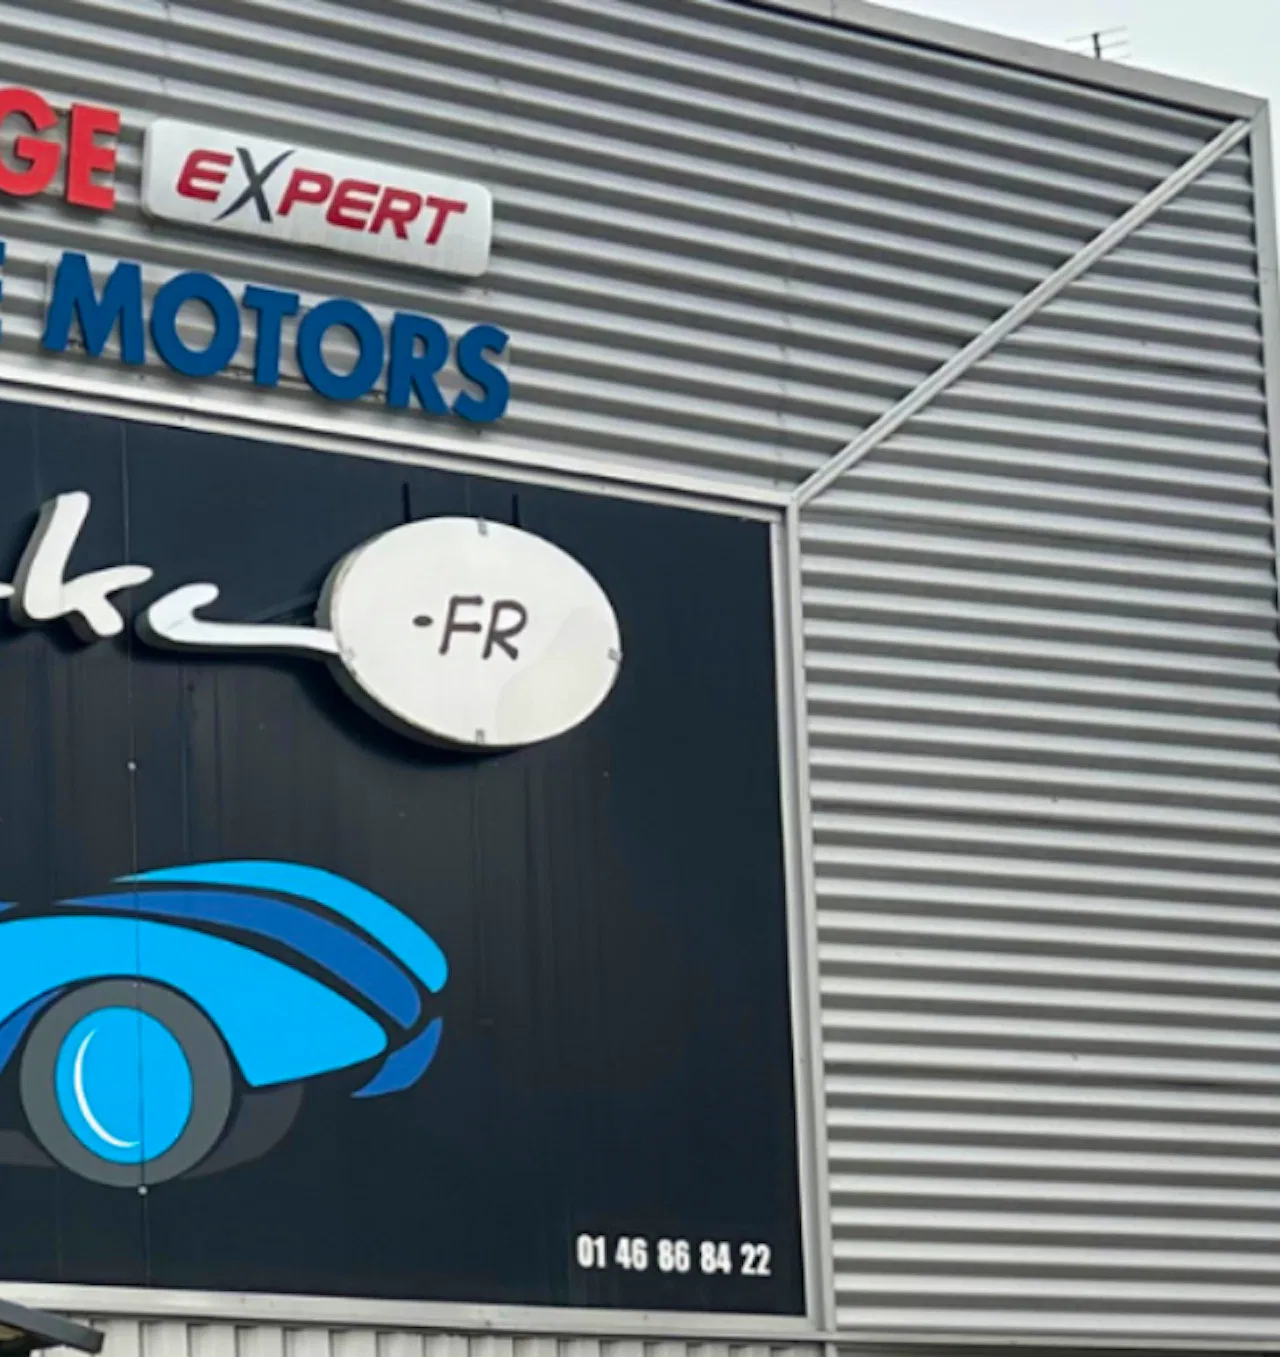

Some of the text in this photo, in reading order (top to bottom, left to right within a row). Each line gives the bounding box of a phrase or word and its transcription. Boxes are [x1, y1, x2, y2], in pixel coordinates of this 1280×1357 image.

[176, 146, 468, 246] EXPERT
[43, 252, 511, 424] MOTORS
[577, 1233, 772, 1276] 01 46 86 84 22
